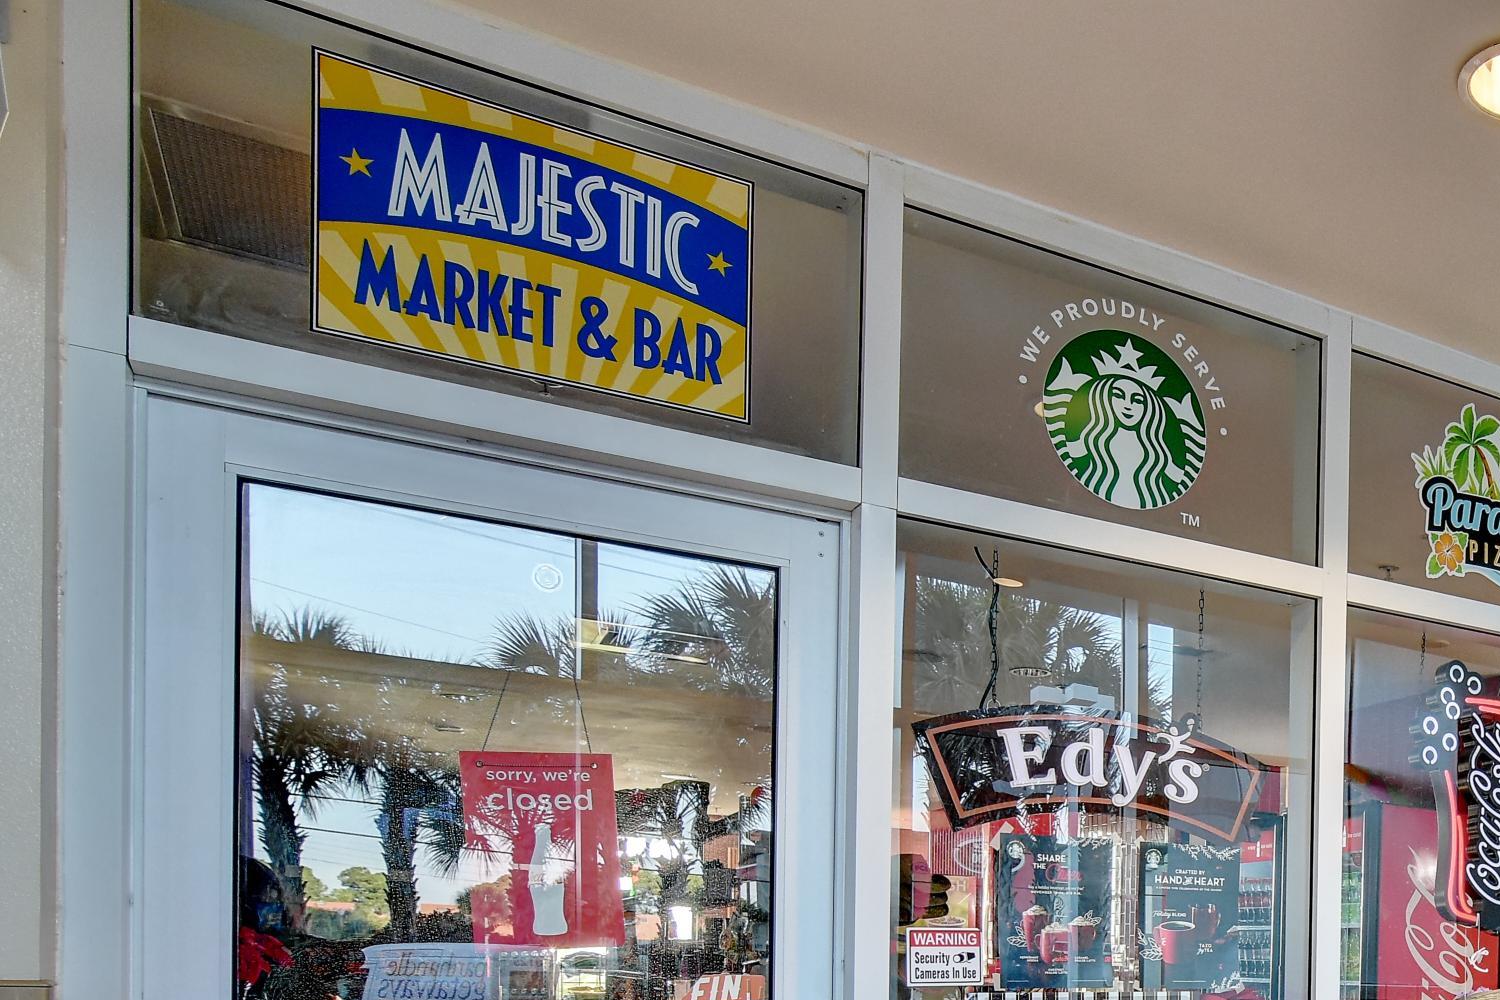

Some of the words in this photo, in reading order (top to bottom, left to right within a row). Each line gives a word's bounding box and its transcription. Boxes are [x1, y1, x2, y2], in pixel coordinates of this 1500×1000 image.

[387, 127, 700, 295] MAJESTIC
[354, 238, 561, 348] MARKET
[577, 295, 618, 363] &
[632, 308, 723, 385] BAR
[1020, 326, 1050, 363] WE
[1051, 298, 1165, 331] PROUDLY
[1172, 333, 1226, 410] SERVE
[1180, 512, 1200, 527] TM
[997, 718, 1204, 807] Edy's
[486, 770, 537, 783] sorry,
[543, 769, 590, 782] we're
[487, 788, 593, 811] closed
[1037, 854, 1066, 862] SHARE
[1155, 875, 1182, 884] HAND
[1194, 877, 1225, 886] HEART
[914, 932, 977, 945] WARNING
[915, 952, 950, 967] Security
[915, 967, 949, 979] Cameras
[952, 968, 960, 979] In
[962, 968, 976, 979] Use
